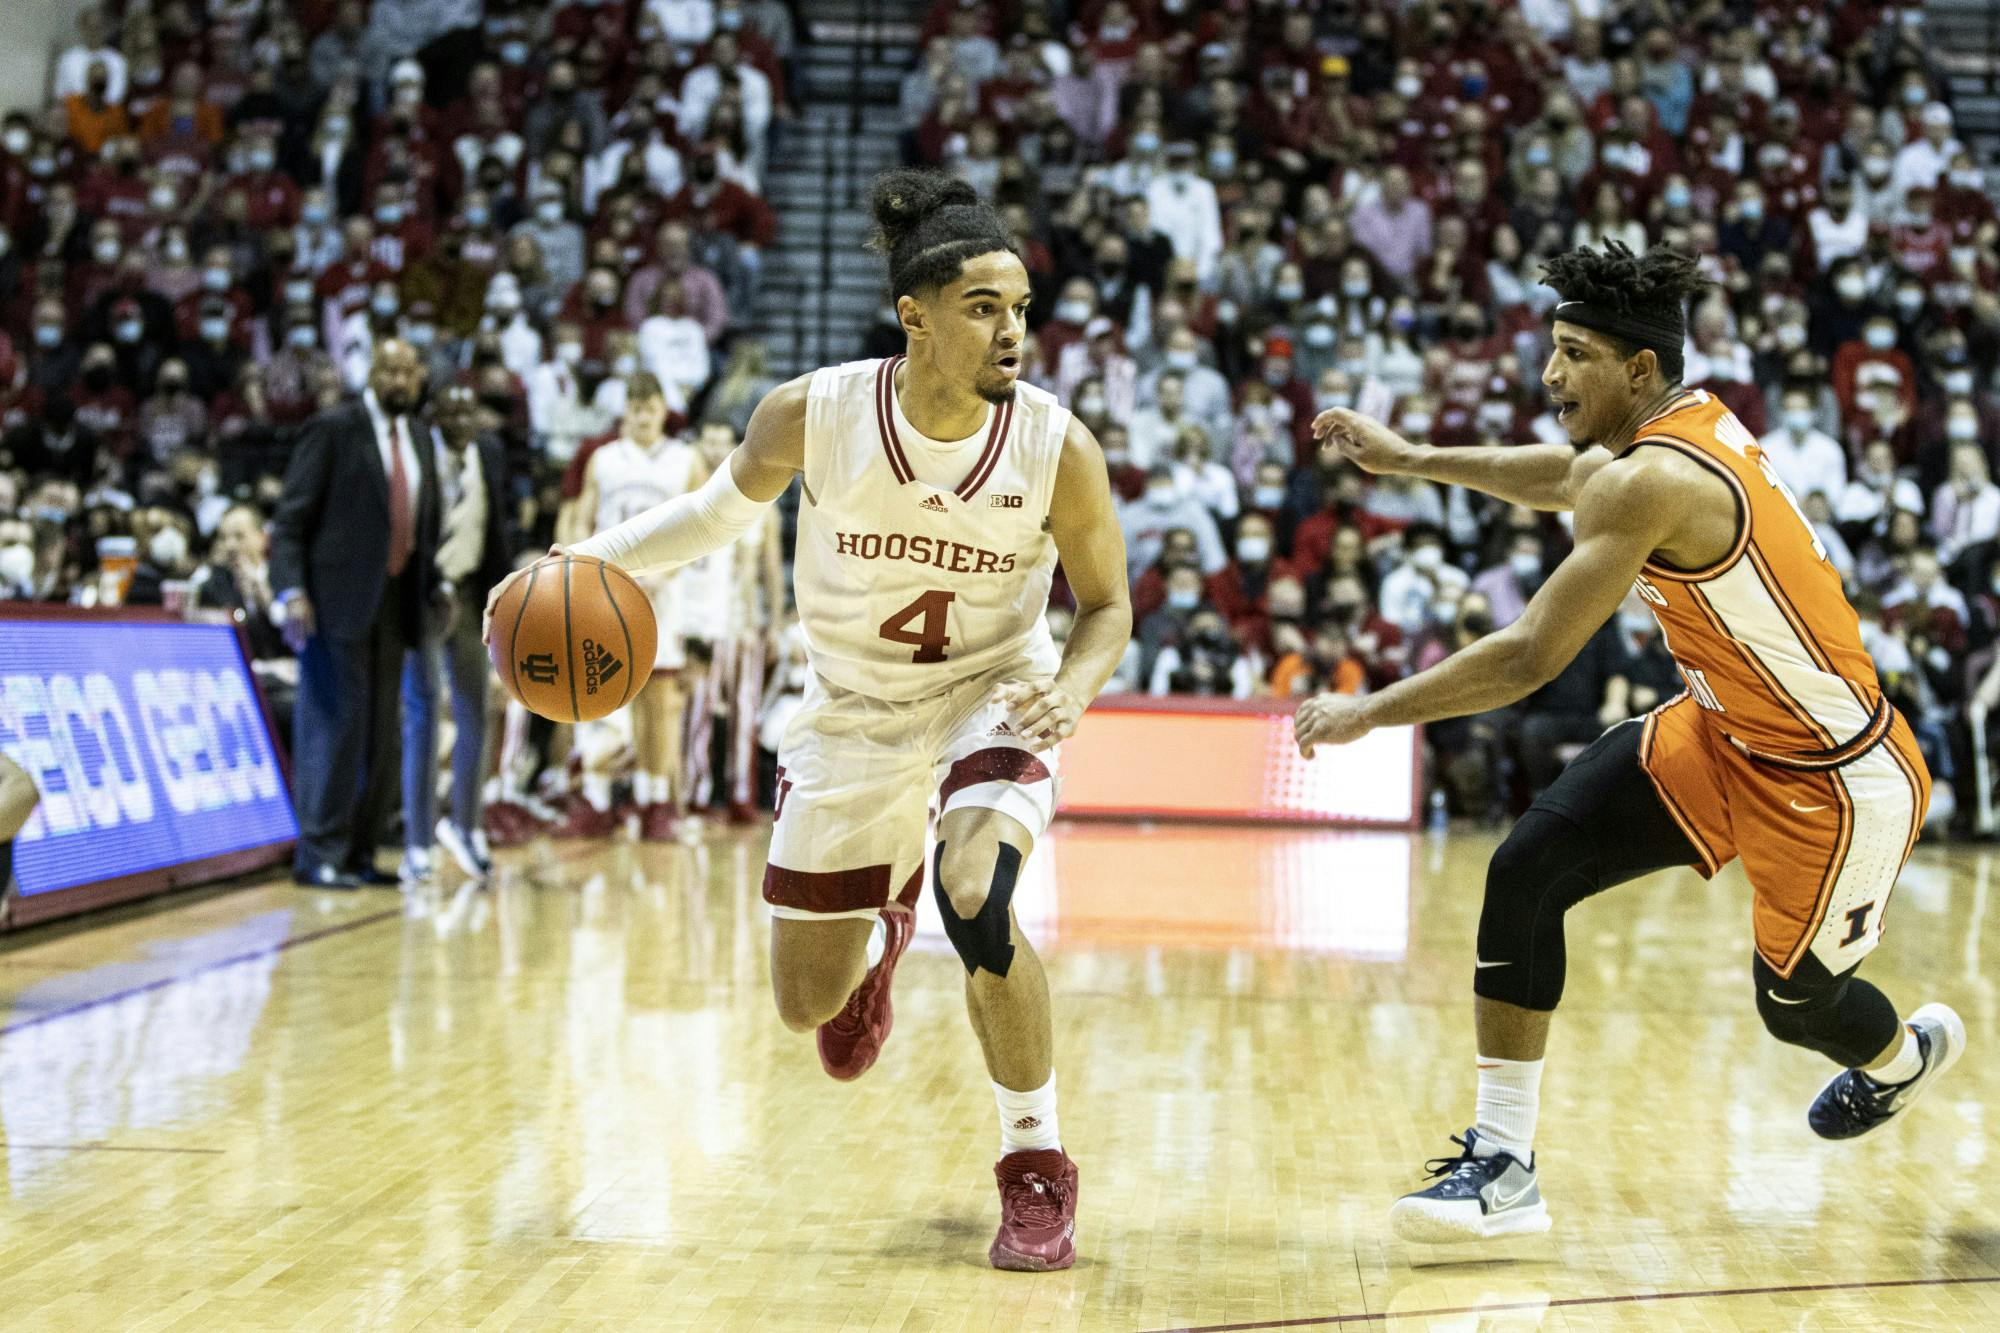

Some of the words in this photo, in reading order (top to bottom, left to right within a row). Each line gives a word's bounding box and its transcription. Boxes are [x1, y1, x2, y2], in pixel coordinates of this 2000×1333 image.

[836, 532, 1017, 573] HOOSIERS
[879, 590, 956, 664] 4
[582, 638, 599, 696] adidas
